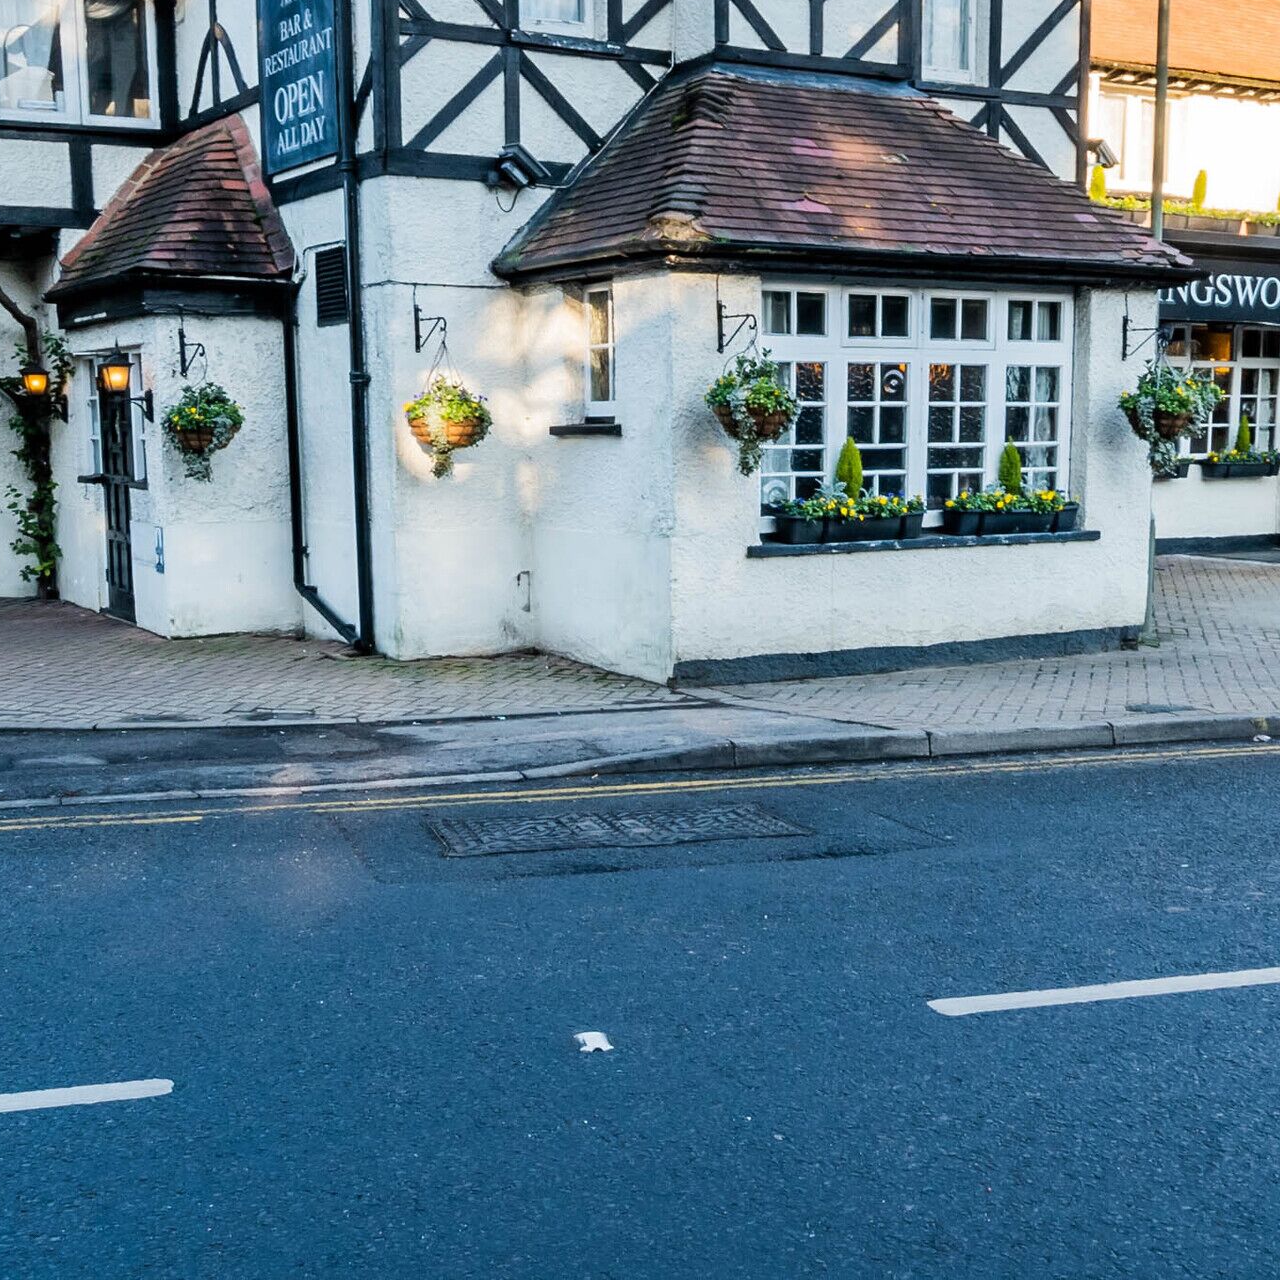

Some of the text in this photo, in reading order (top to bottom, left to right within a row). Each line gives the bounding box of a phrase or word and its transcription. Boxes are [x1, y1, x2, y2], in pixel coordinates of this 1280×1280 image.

[280, 8, 313, 42] BAR &
[264, 27, 332, 78] RESTAURANT
[274, 70, 324, 125] OPEN
[277, 115, 326, 156] ALL DAY
